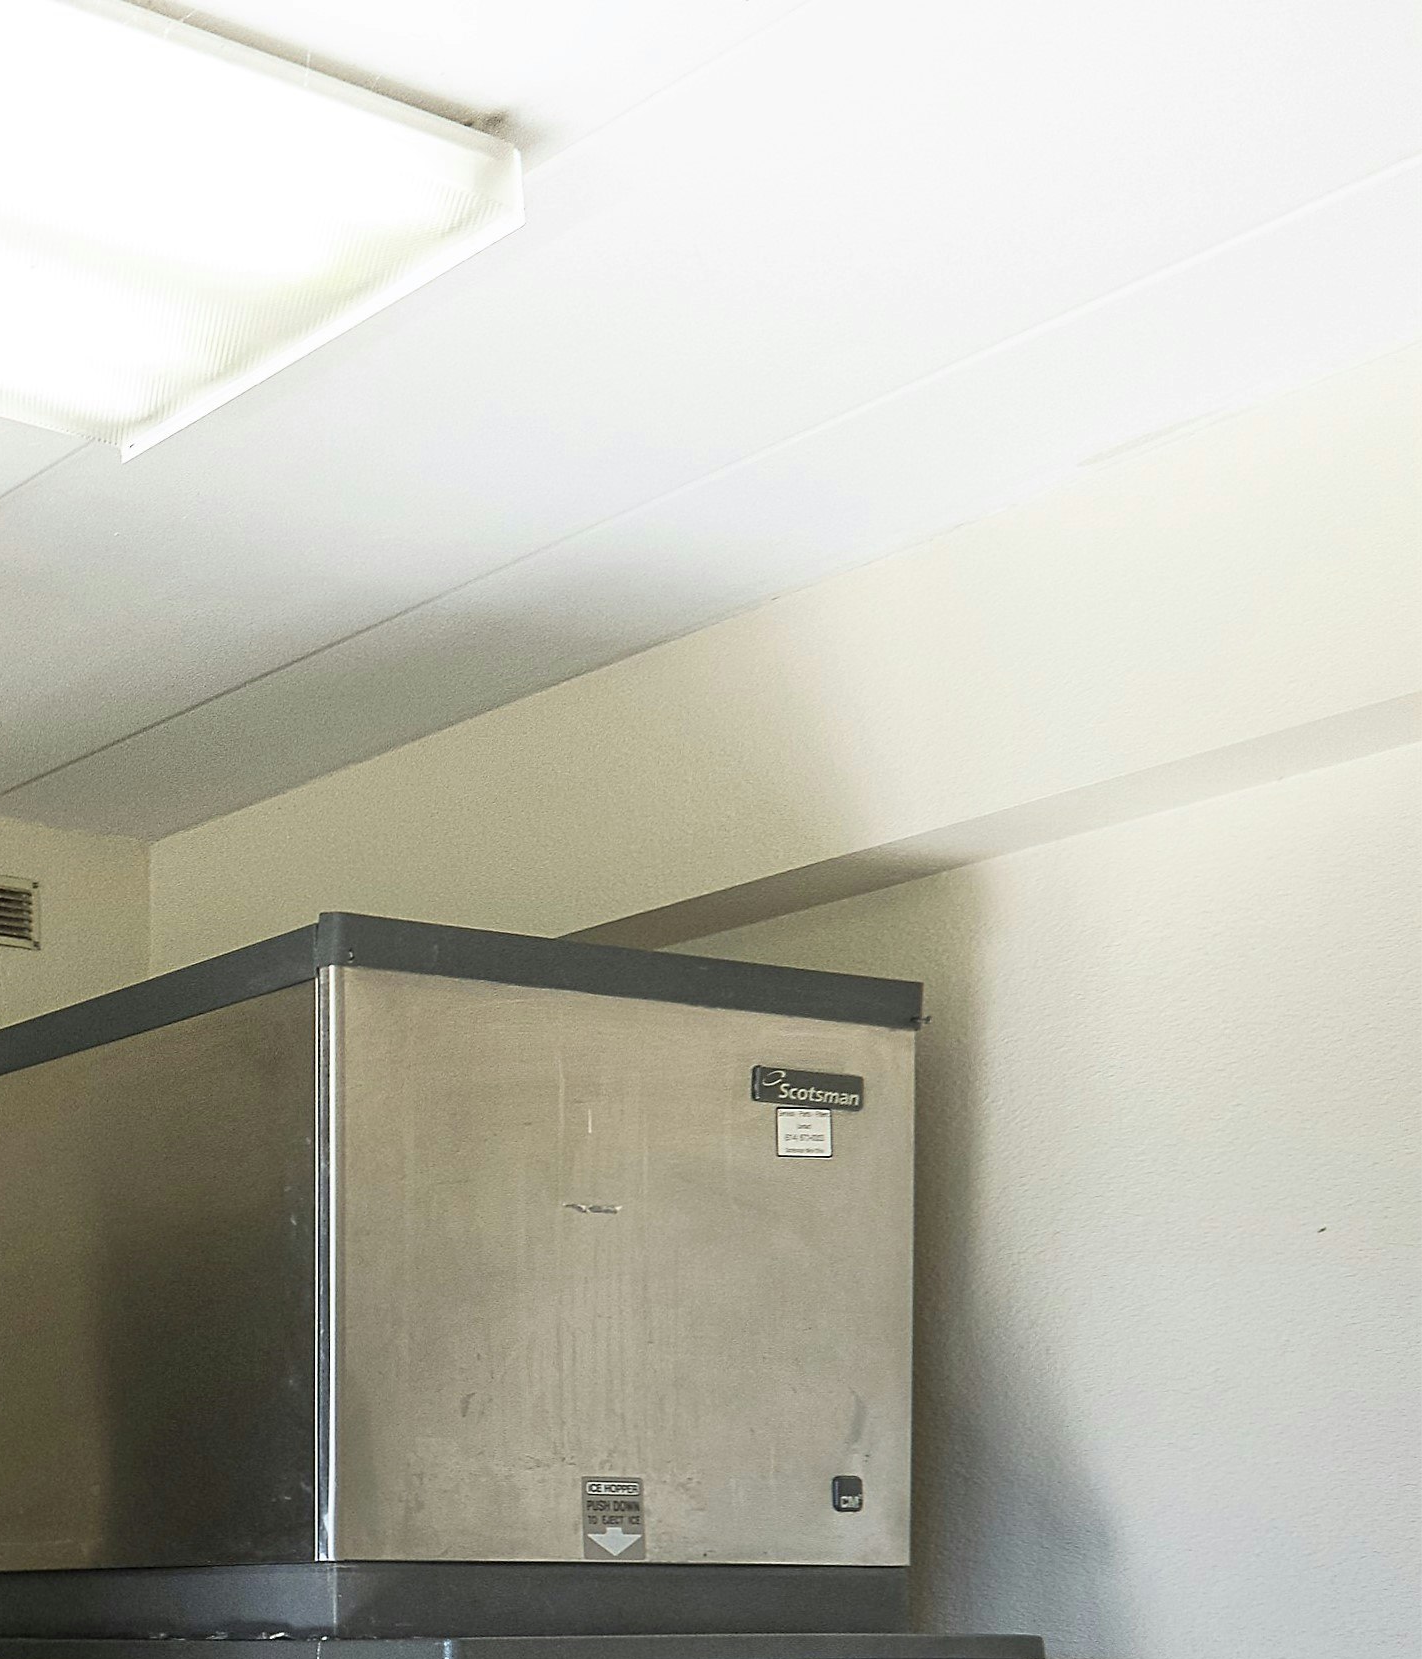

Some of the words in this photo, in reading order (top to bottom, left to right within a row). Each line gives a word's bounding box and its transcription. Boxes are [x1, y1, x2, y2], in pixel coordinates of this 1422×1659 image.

[778, 1083, 860, 1106] Scotsman
[589, 1483, 602, 1492] ICE
[604, 1484, 638, 1493] HOPPER
[586, 1500, 611, 1511] PUSH
[613, 1501, 640, 1512] DOWN
[588, 1515, 597, 1524] TO
[602, 1515, 624, 1525] EJECT
[629, 1516, 641, 1525] ICE
